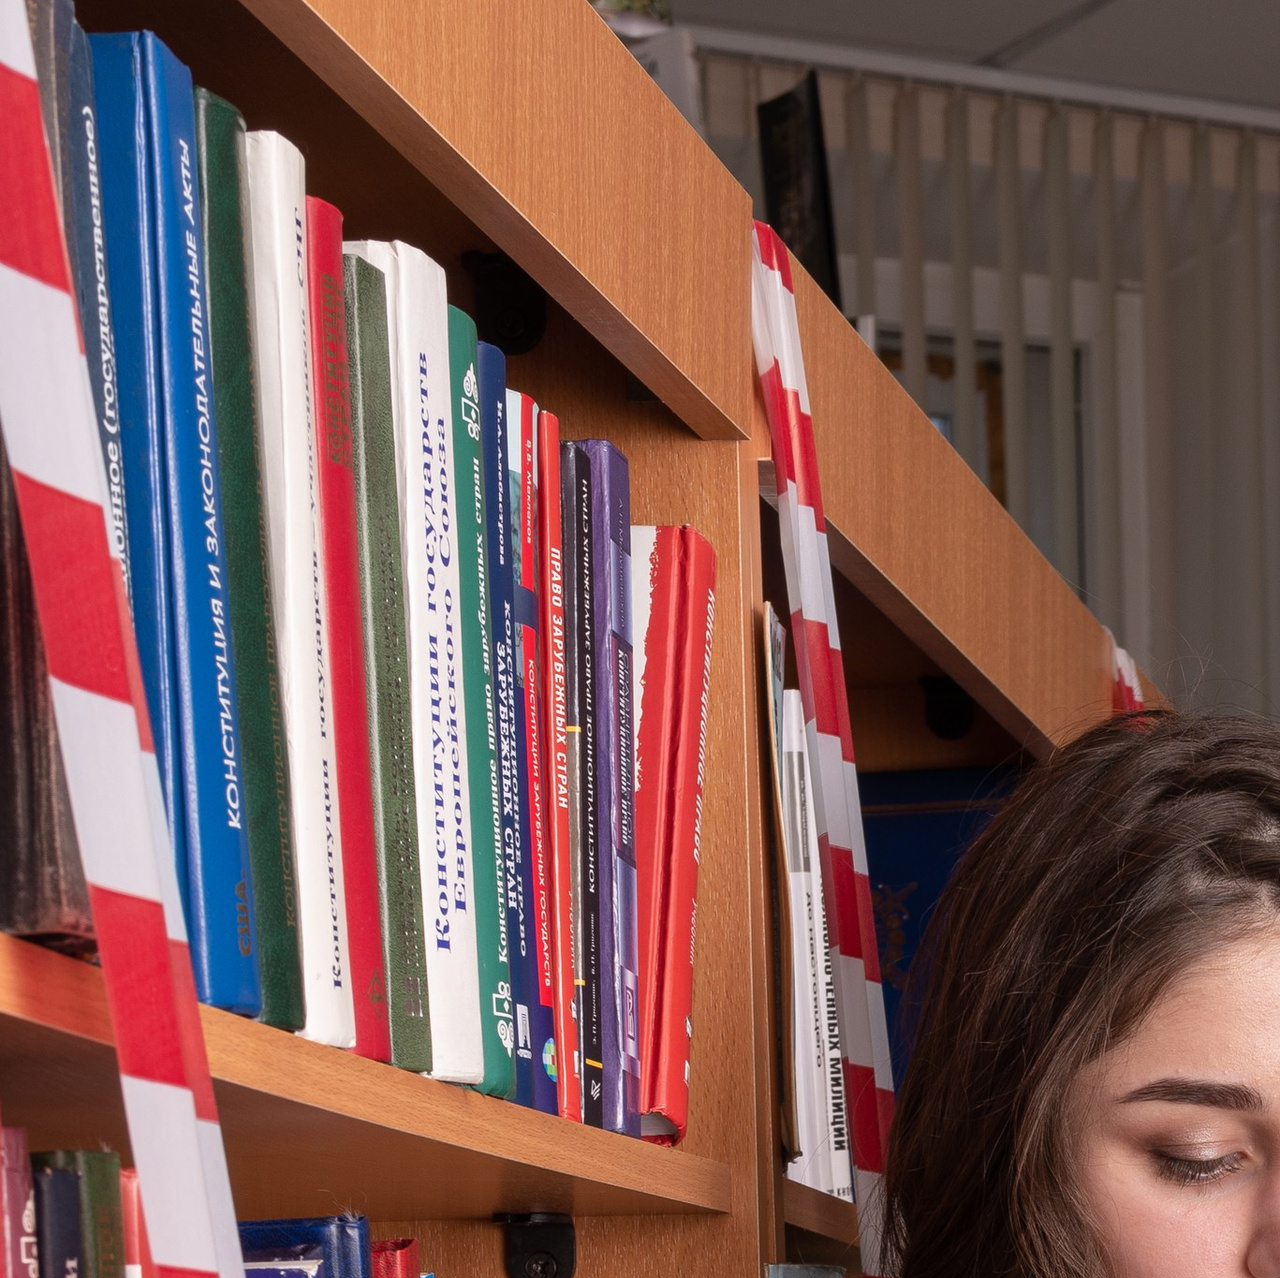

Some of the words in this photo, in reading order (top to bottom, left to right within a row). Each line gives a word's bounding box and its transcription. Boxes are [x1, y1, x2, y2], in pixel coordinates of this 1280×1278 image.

[179, 138, 195, 225] АКТЫ
[294, 207, 304, 288] СНГ
[82, 106, 118, 434] (государственное)
[186, 231, 219, 556] ЗАКОНОДАТЕЛЬНЫЕ
[322, 273, 341, 464] КОНСТИТУЦИИ
[419, 352, 438, 613] государств
[437, 417, 452, 567] Союза
[472, 456, 483, 523] стран
[525, 470, 534, 544] Маклаков
[208, 564, 222, 588] И
[313, 551, 326, 739] государств
[476, 532, 491, 675] зарубежных
[551, 546, 561, 607] ПРАВО
[582, 536, 591, 650] ЗАРУБЕЖНЫХ
[211, 599, 241, 829] КОНСТИТУЦИЯ
[485, 683, 496, 750] право
[523, 658, 544, 776] КОНСТИТУЦИИ
[551, 614, 568, 744] ЗАРУБЕЖНЫХ
[584, 653, 592, 710] ПРАВО
[268, 673, 296, 927] КОНСТИТУЦИОННОЕ
[428, 634, 451, 952] Конституции
[444, 589, 467, 914] Европейского
[494, 641, 513, 816] ЗАРУБЕЖНЫХ
[504, 826, 518, 909] СТРАН
[501, 599, 522, 863] КОНСТИТУЦИОННОЕ
[516, 874, 527, 956] ПРАВО
[555, 751, 569, 808] СТРАН
[586, 714, 594, 893] КОНСТИТУЦИОННОЕ
[322, 759, 342, 988] Конституции
[489, 759, 508, 962] Конституционное
[533, 780, 545, 886] ЗАРУБЕЖНЫХ
[539, 889, 551, 986] ГОСУДАРСТВ
[827, 1057, 847, 1151] МИЛИЦИИ
